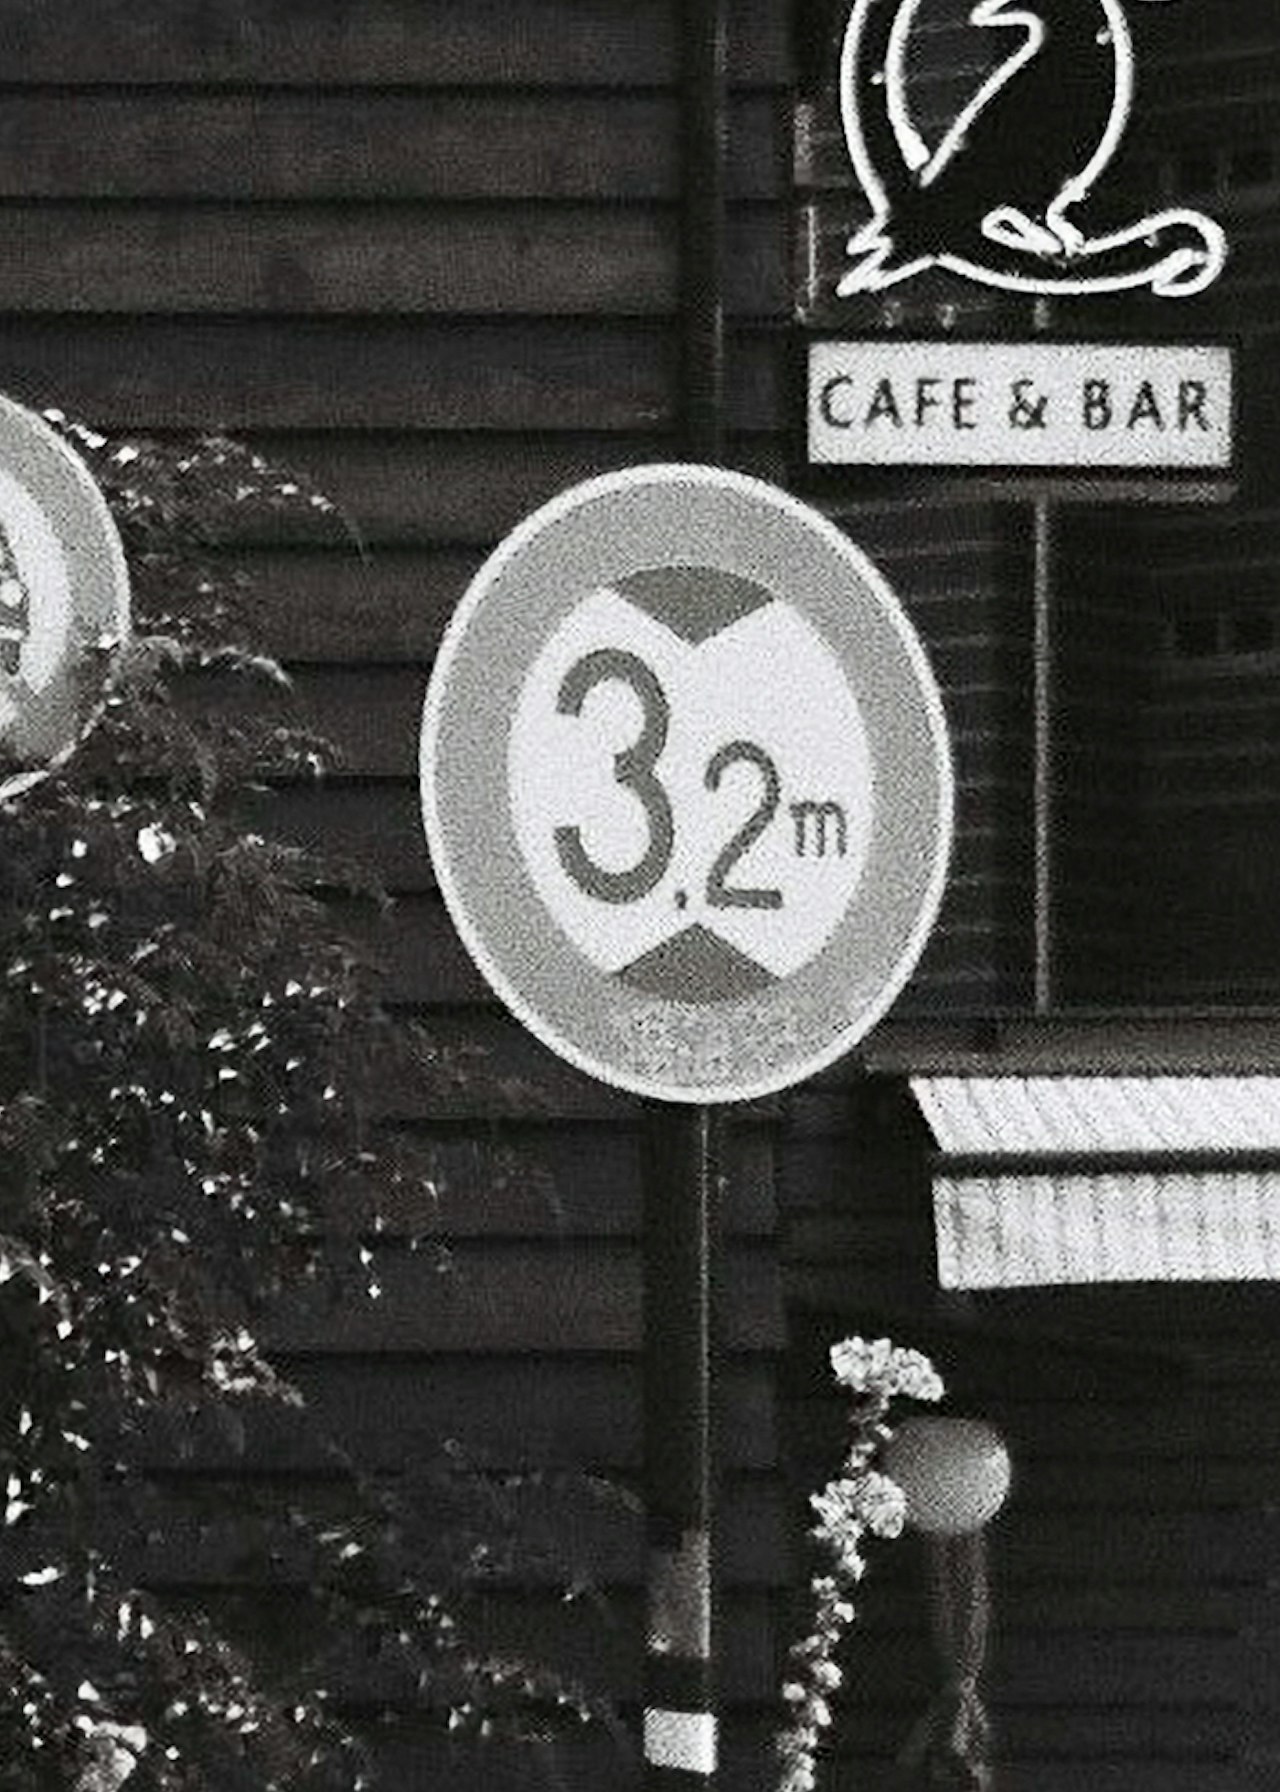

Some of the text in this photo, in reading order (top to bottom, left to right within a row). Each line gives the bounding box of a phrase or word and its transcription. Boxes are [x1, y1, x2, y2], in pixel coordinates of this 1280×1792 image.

[820, 375, 1213, 432] CAFE & BAR
